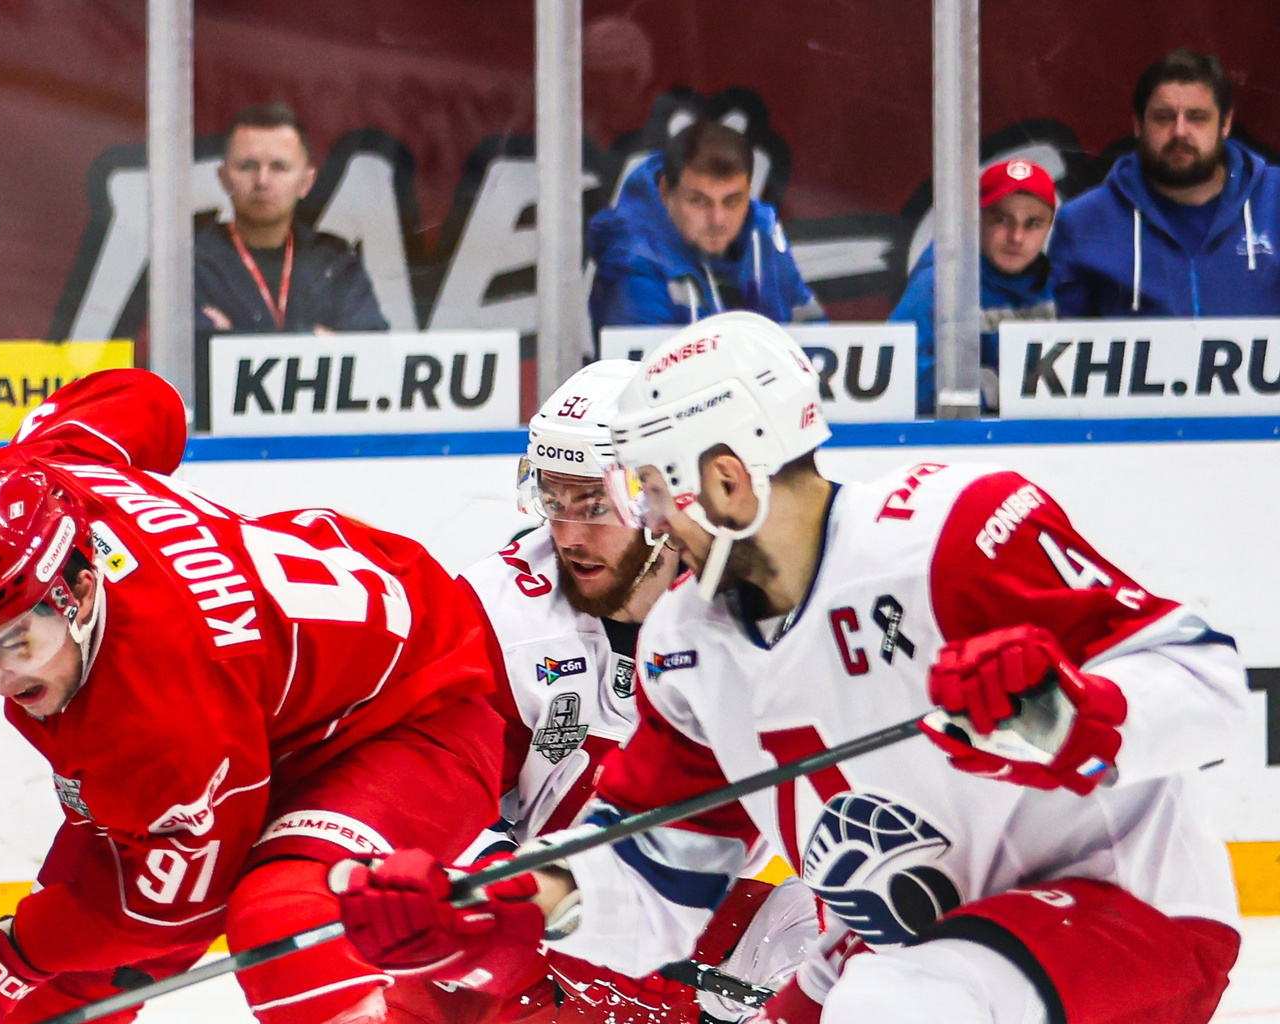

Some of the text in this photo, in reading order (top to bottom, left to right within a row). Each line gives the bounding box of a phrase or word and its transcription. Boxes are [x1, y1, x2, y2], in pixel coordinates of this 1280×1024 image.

[233, 354, 498, 415] KHL.RU
[1020, 339, 1280, 399] KHL.RU
[41, 524, 73, 575] OLIMPBET
[975, 485, 1046, 560] FONBET
